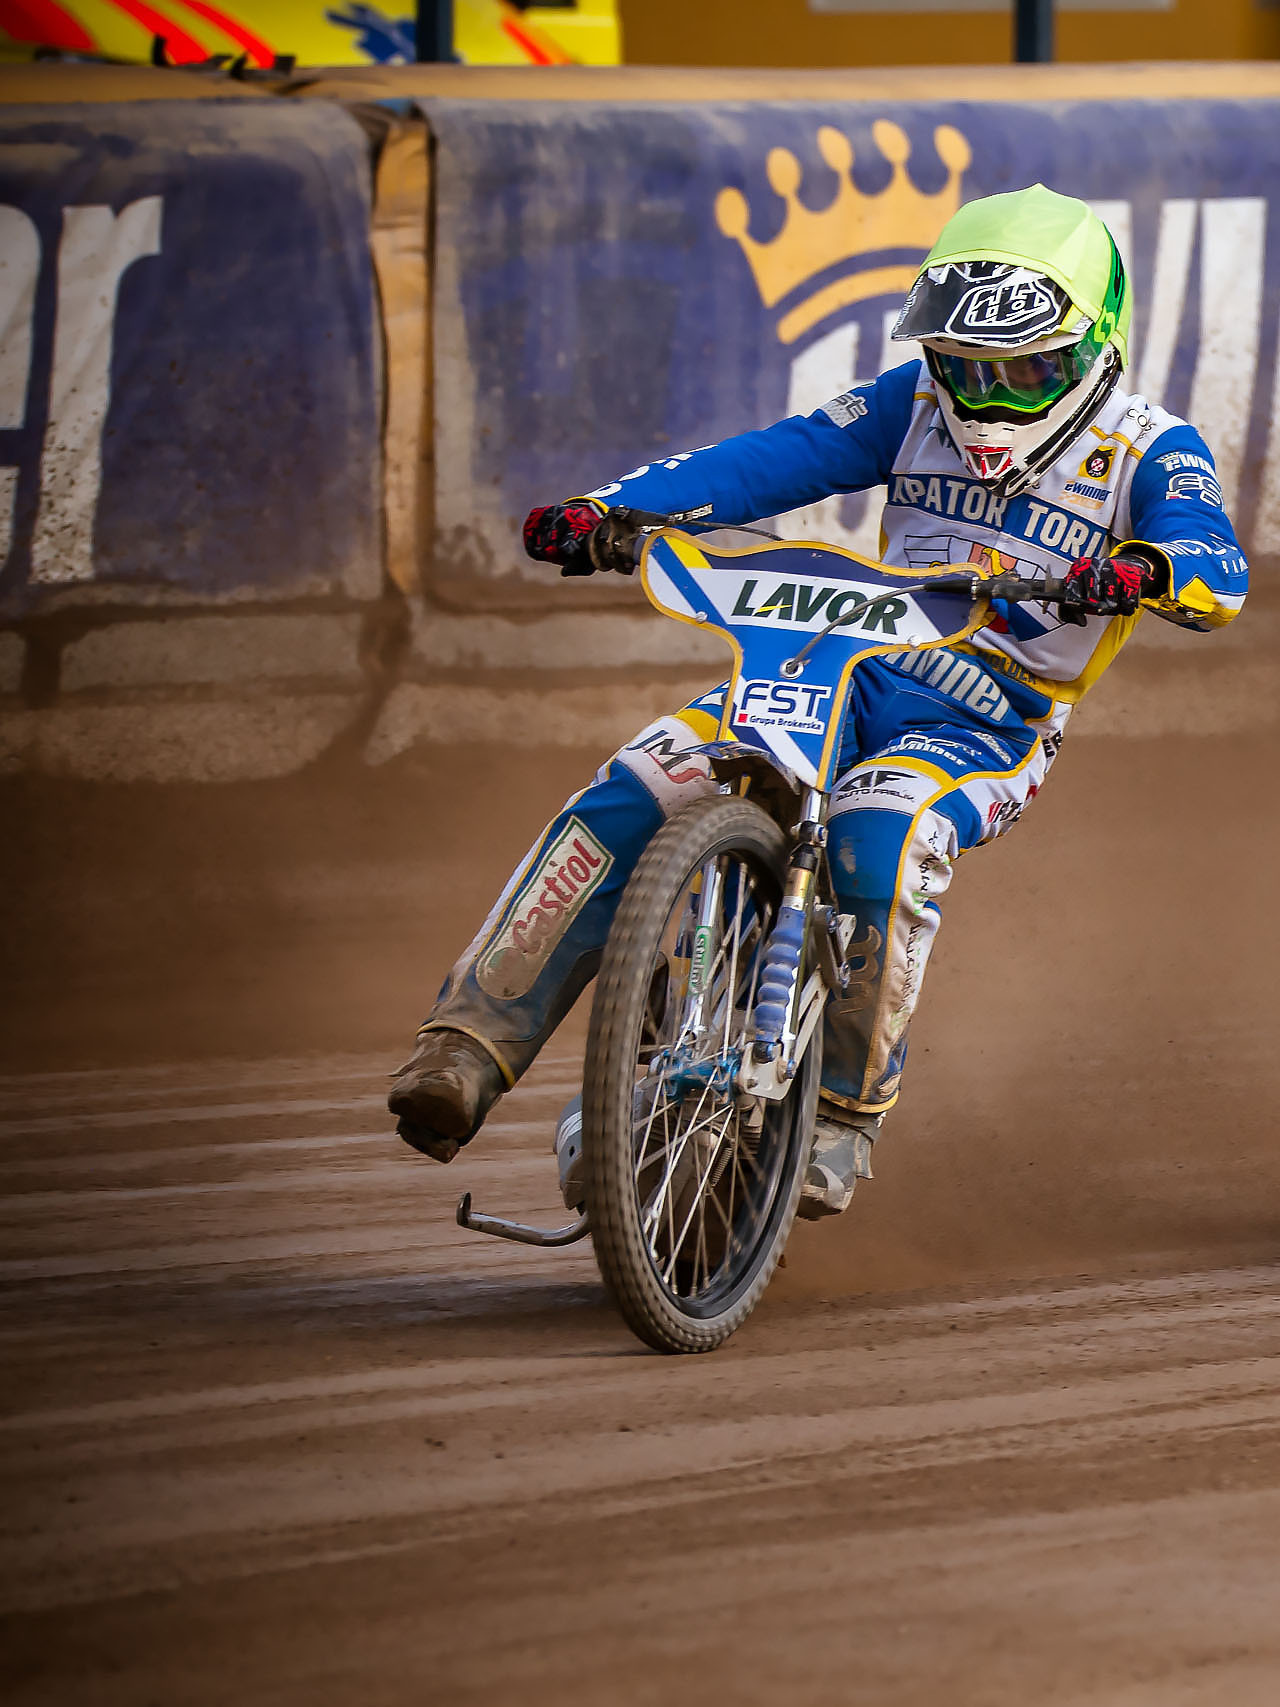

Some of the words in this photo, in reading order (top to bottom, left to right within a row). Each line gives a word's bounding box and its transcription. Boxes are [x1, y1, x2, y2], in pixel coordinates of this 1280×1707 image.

[730, 579, 908, 636] LAVOR
[740, 682, 828, 717] FST
[749, 715, 776, 727] Grupa
[777, 717, 821, 730] Brokerska
[512, 837, 602, 954] Castrol
